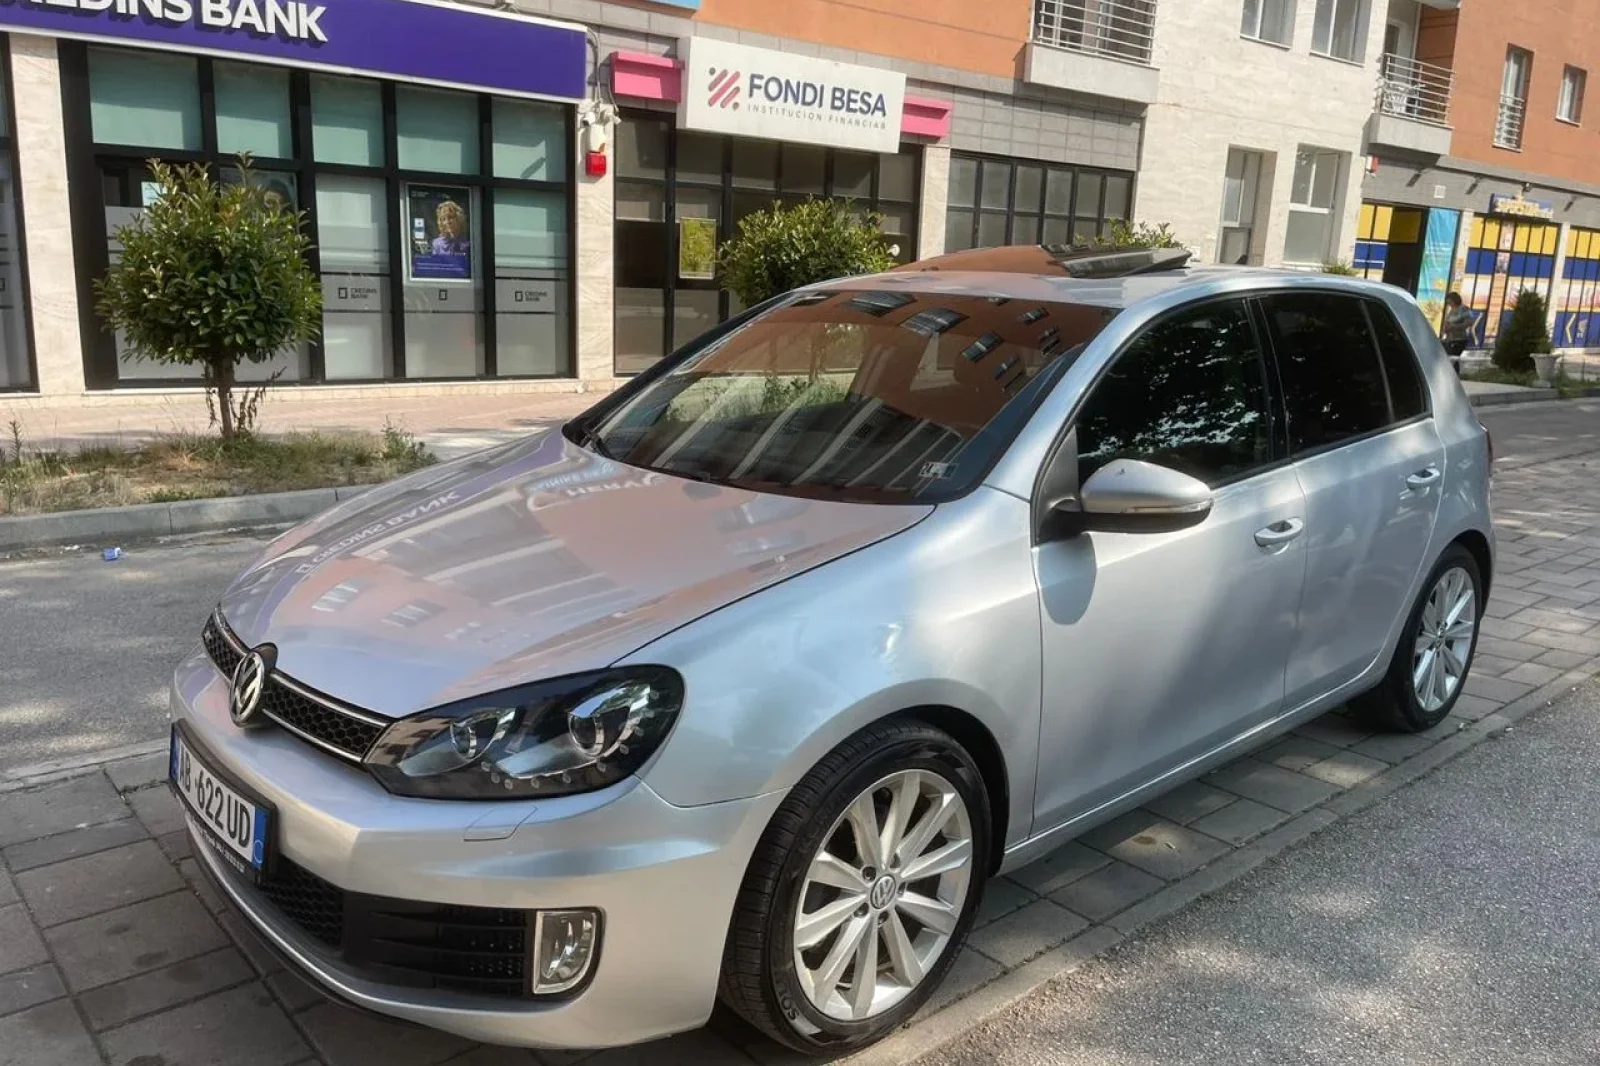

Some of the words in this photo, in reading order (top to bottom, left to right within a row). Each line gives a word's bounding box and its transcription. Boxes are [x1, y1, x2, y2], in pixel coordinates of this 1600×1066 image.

[202, 0, 328, 42] BANK
[749, 73, 825, 109] FONDI
[830, 87, 887, 118] BESA
